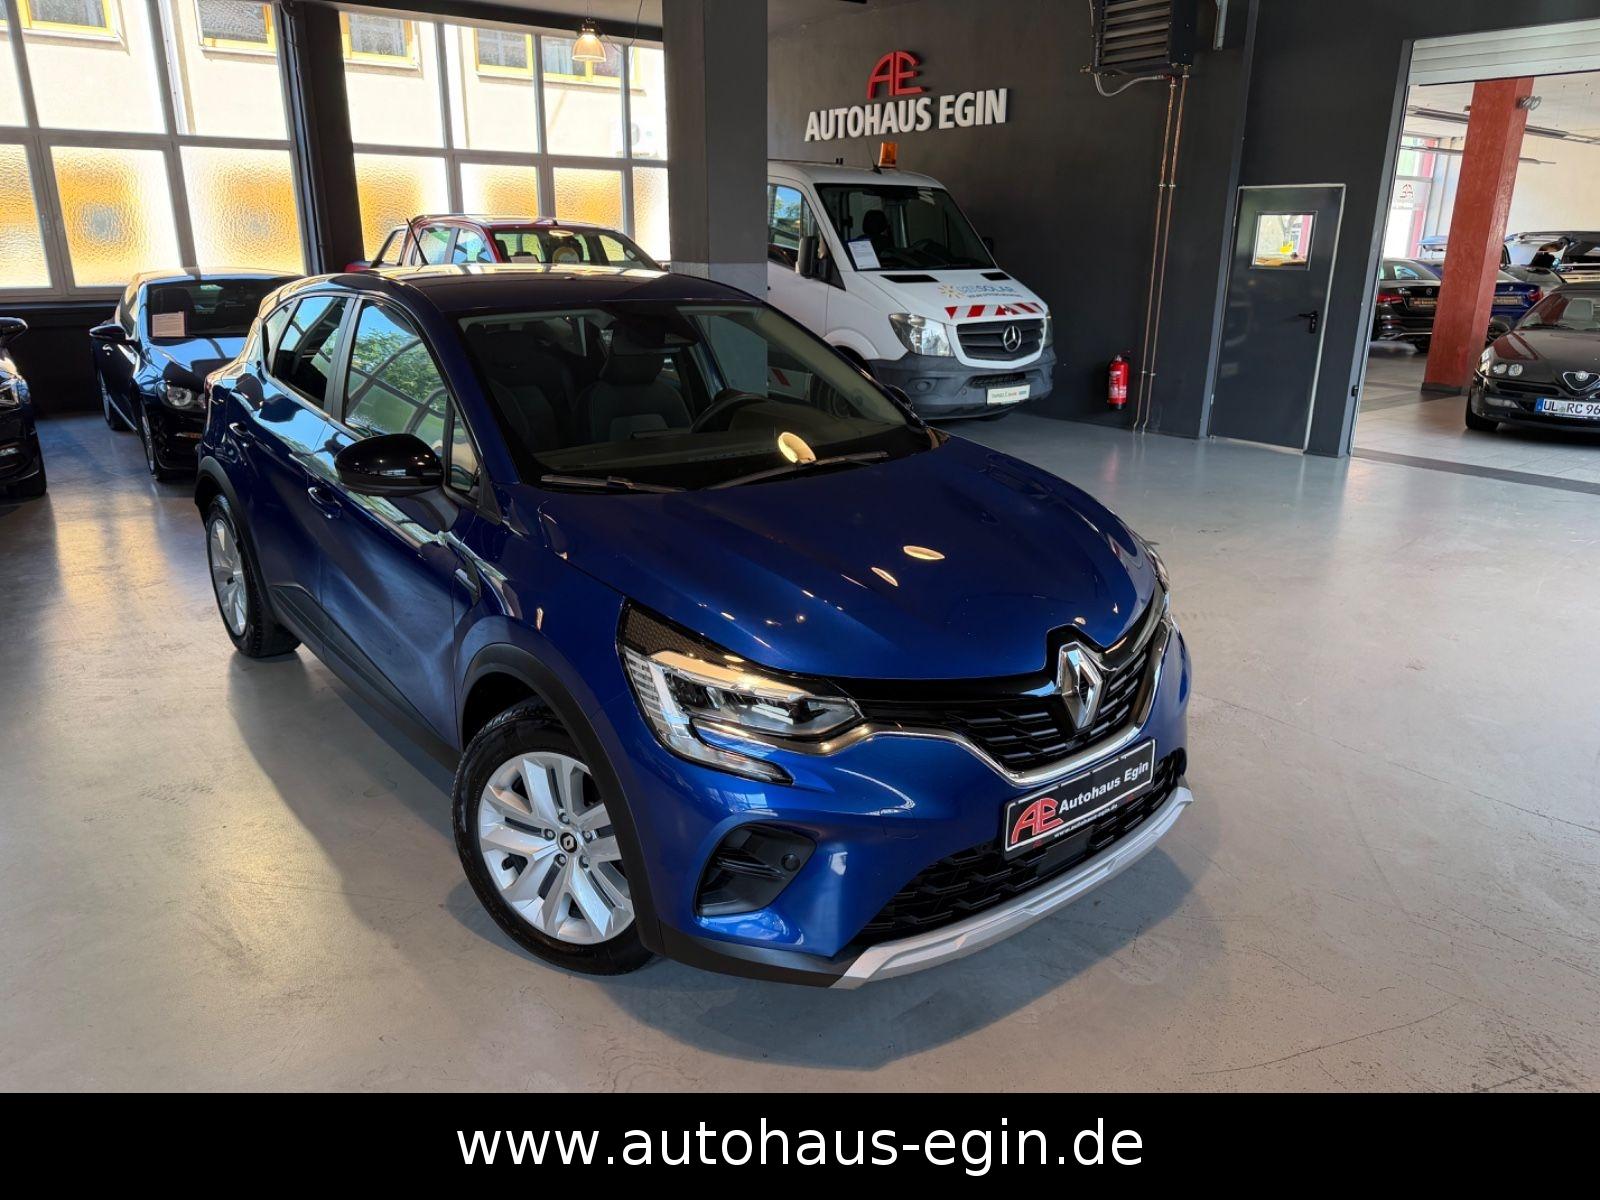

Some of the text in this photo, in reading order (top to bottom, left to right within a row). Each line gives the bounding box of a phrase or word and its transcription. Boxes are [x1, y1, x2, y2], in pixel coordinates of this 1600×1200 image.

[804, 88, 1008, 142] AUTOHAUS EGIN
[1544, 401, 1557, 412] UL
[1566, 403, 1583, 413] RC
[1059, 776, 1120, 814] Autohaus
[1124, 761, 1148, 782] Egin
